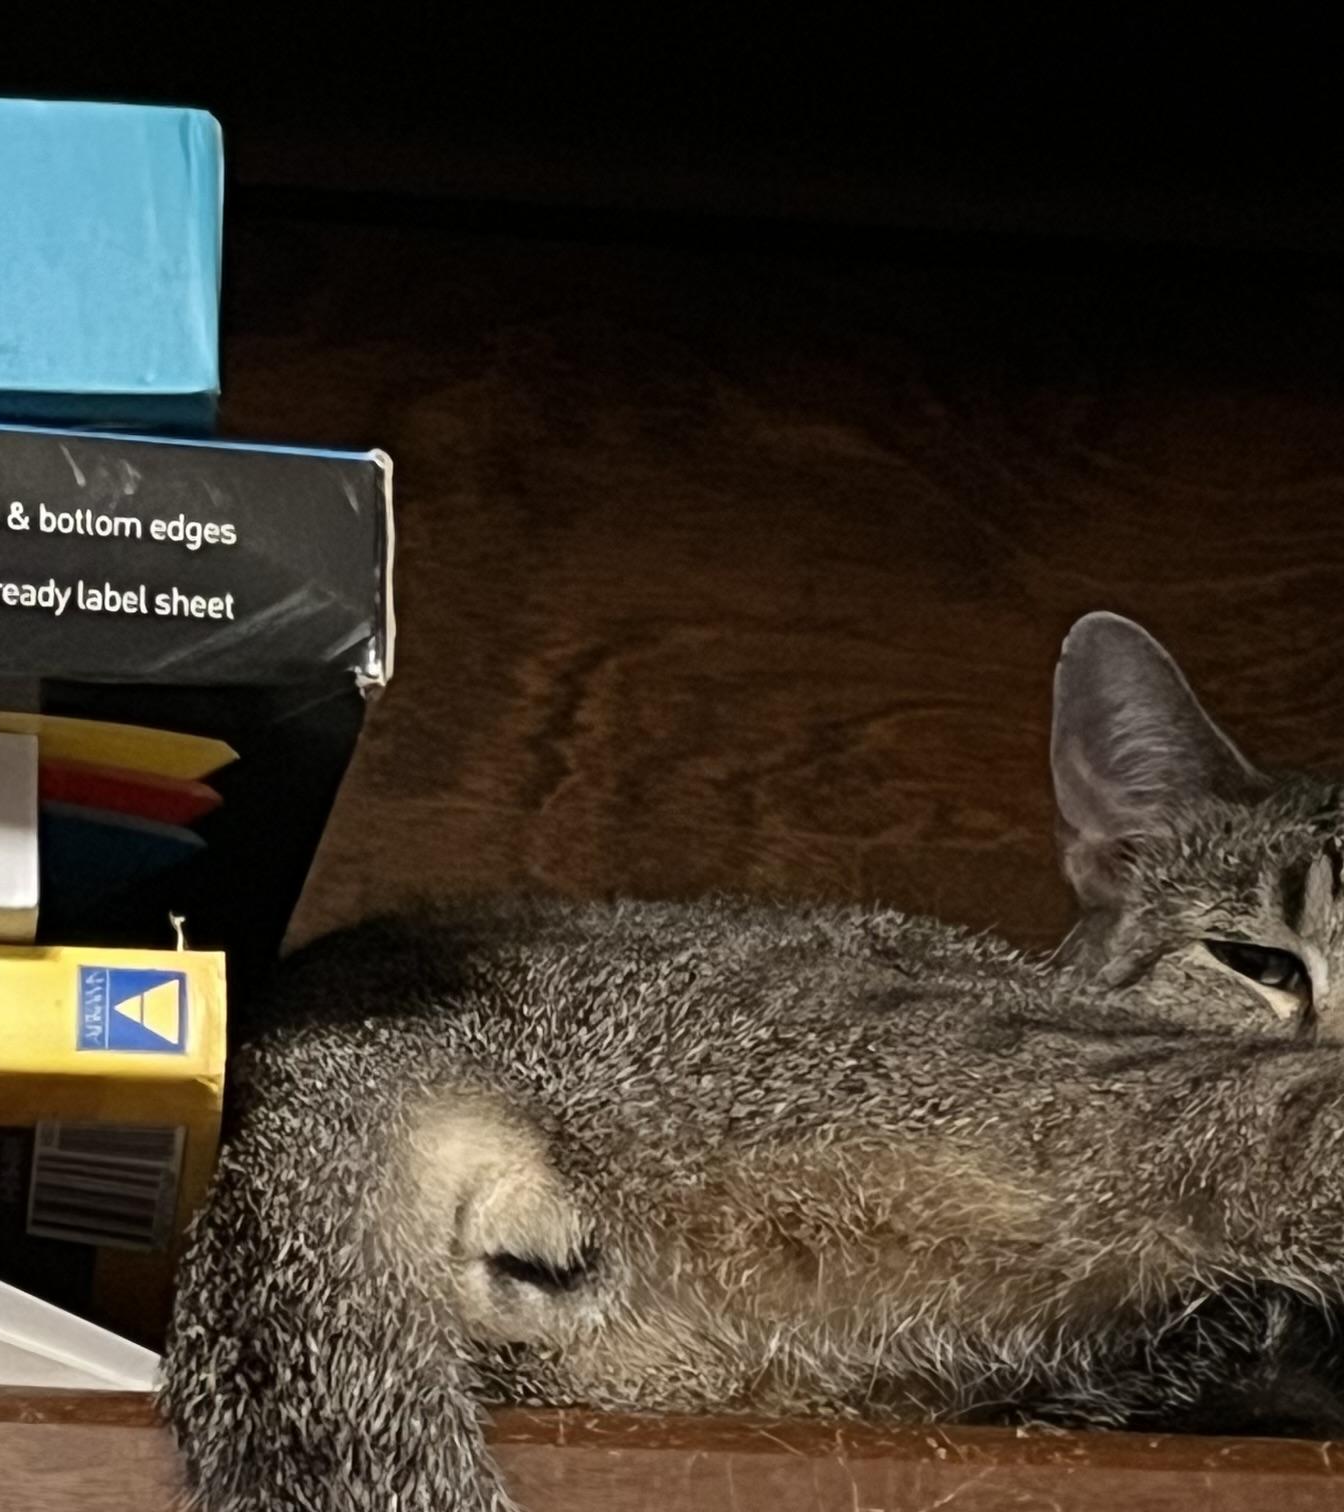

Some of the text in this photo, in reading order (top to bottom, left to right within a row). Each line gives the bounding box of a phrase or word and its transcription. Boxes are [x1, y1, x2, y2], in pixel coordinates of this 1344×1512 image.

[7, 503, 31, 531] &
[38, 505, 143, 539] bottom
[149, 513, 238, 549] edges
[76, 580, 147, 615] label
[154, 587, 236, 620] sheet
